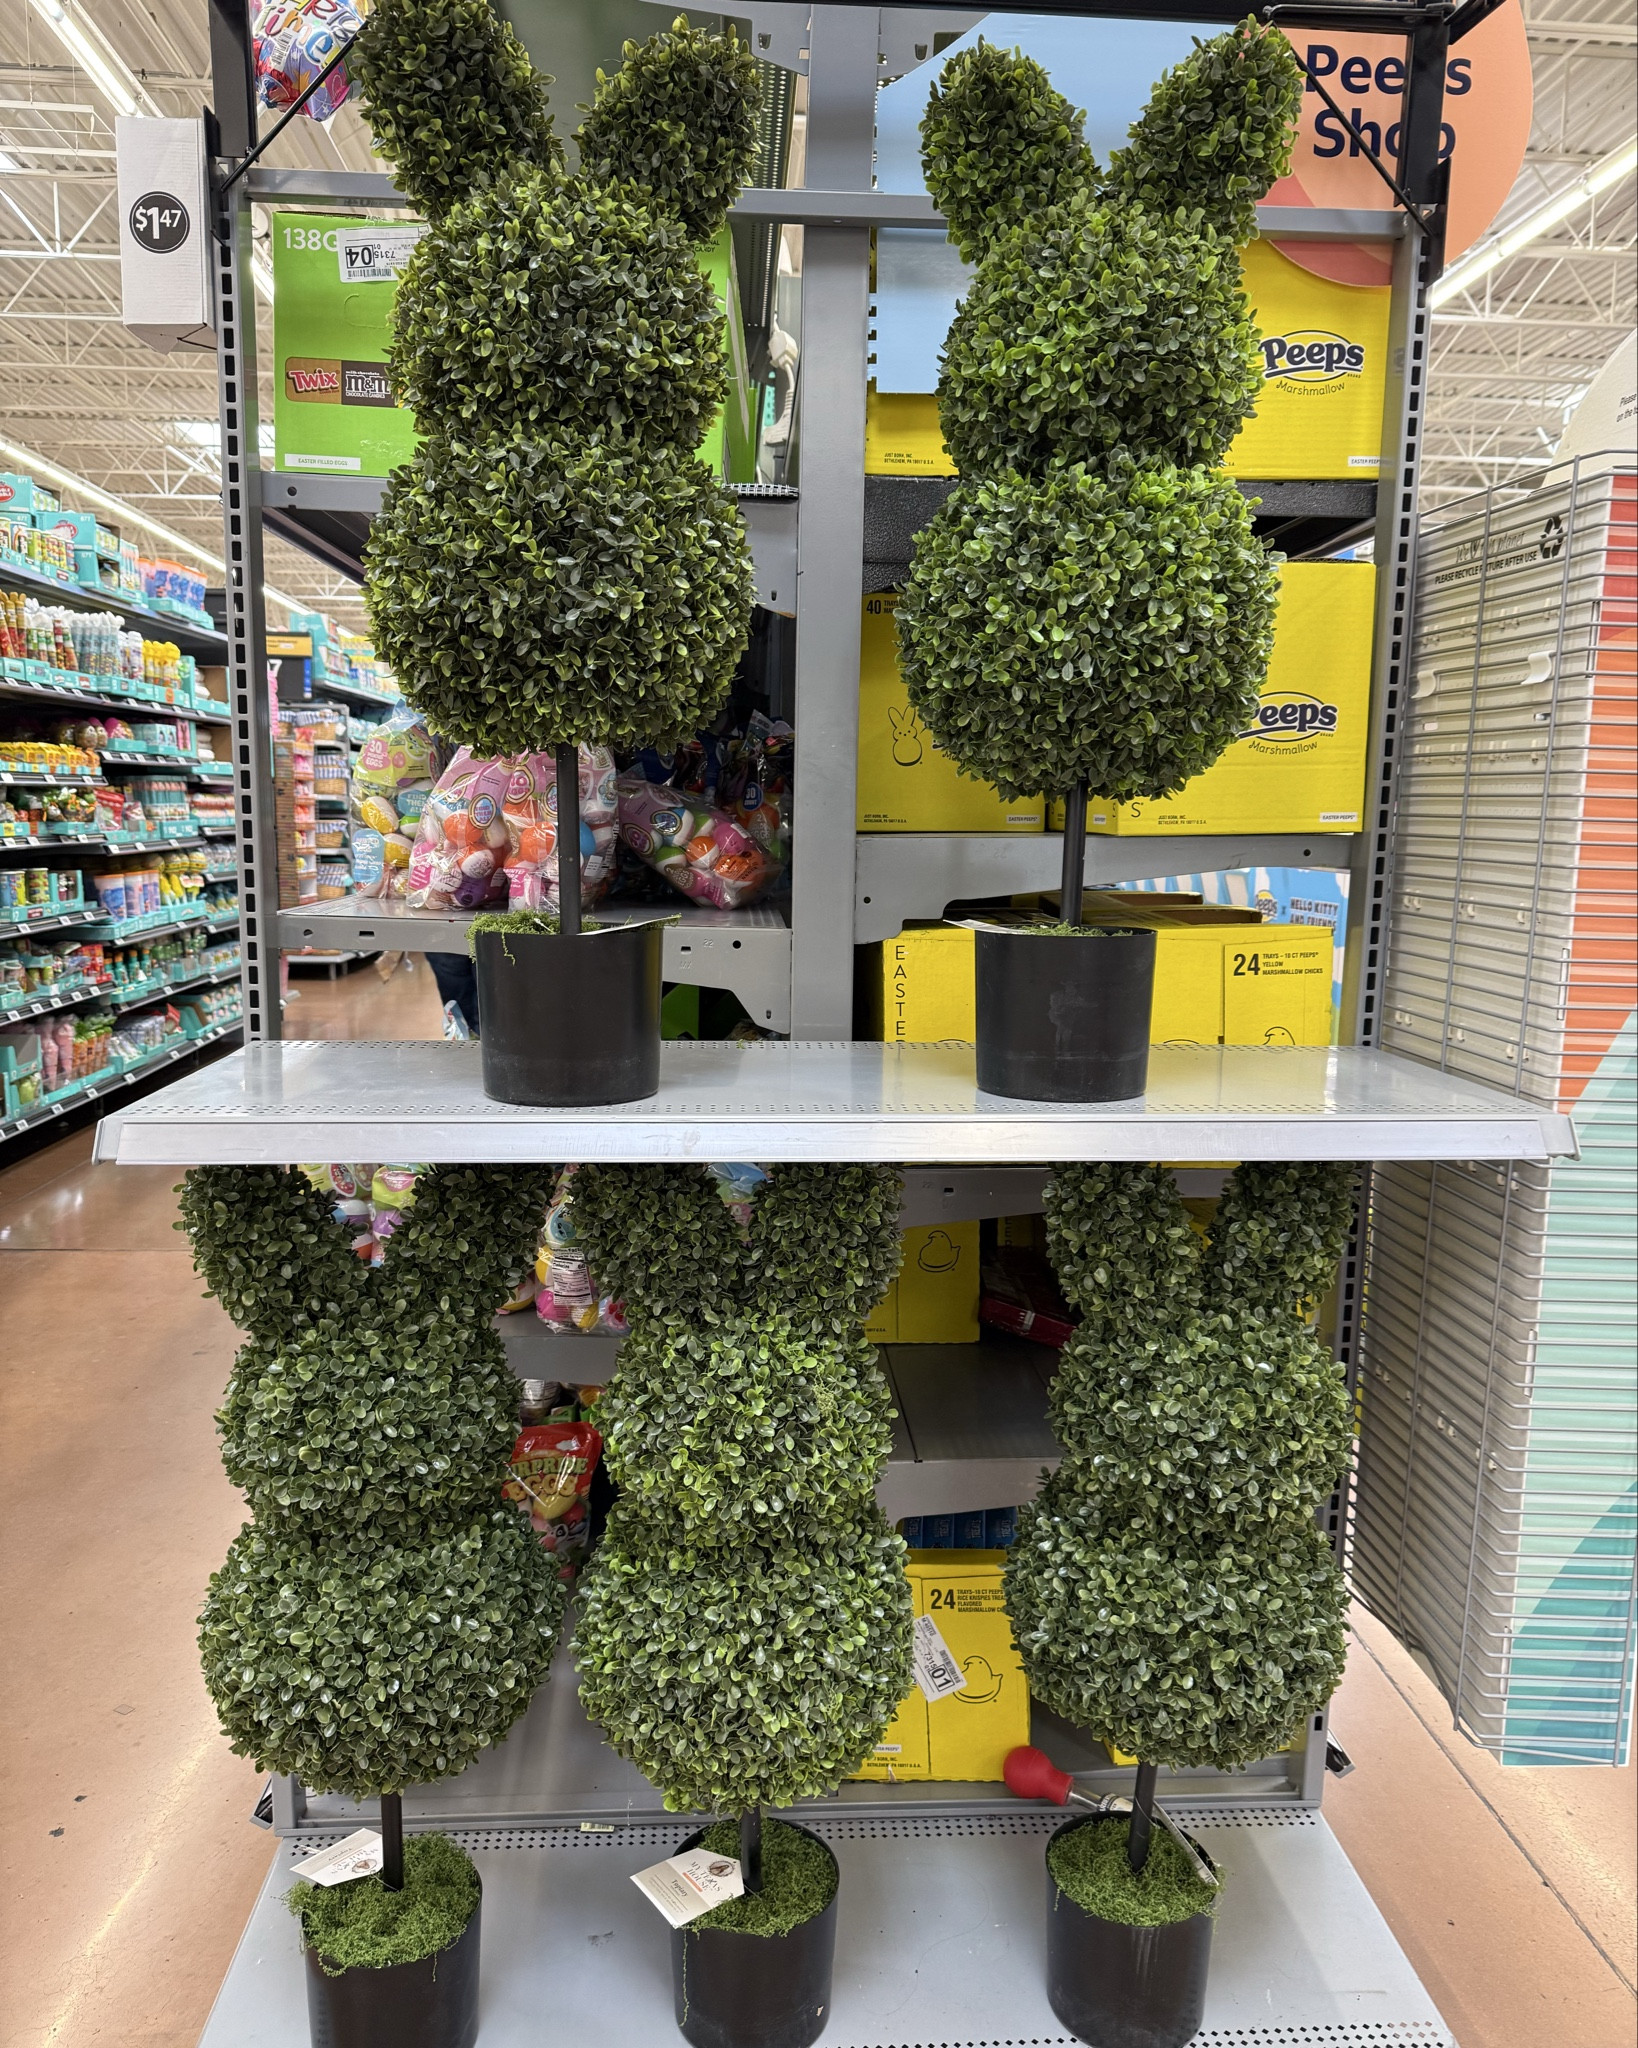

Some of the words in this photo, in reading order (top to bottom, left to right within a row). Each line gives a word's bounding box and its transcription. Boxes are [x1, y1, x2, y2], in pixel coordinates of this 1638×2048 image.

[1305, 44, 1473, 96] Pees
[346, 246, 373, 267] 04
[1258, 337, 1365, 373] Peeps
[289, 367, 339, 391] Twix
[1276, 380, 1345, 396] Marshmallow
[1434, 572, 1454, 584] PLEASE
[1455, 566, 1479, 580] RECYCLE
[1480, 559, 1504, 573] FXTURE
[1504, 554, 1525, 567] AFTER
[1524, 550, 1538, 563] USE
[866, 600, 882, 614] 40
[1252, 703, 1338, 733] eeps
[369, 740, 382, 754] 30
[1248, 740, 1318, 755] Marshmallow
[1290, 897, 1312, 913] HELLO
[1314, 901, 1339, 917] KITTY
[1233, 953, 1261, 976] 24
[893, 945, 907, 1042] EASTE
[930, 1588, 956, 1610] 24
[931, 1667, 953, 1688] 01
[671, 1879, 689, 1898] Topiary
[702, 1871, 723, 1892] TEXAS
